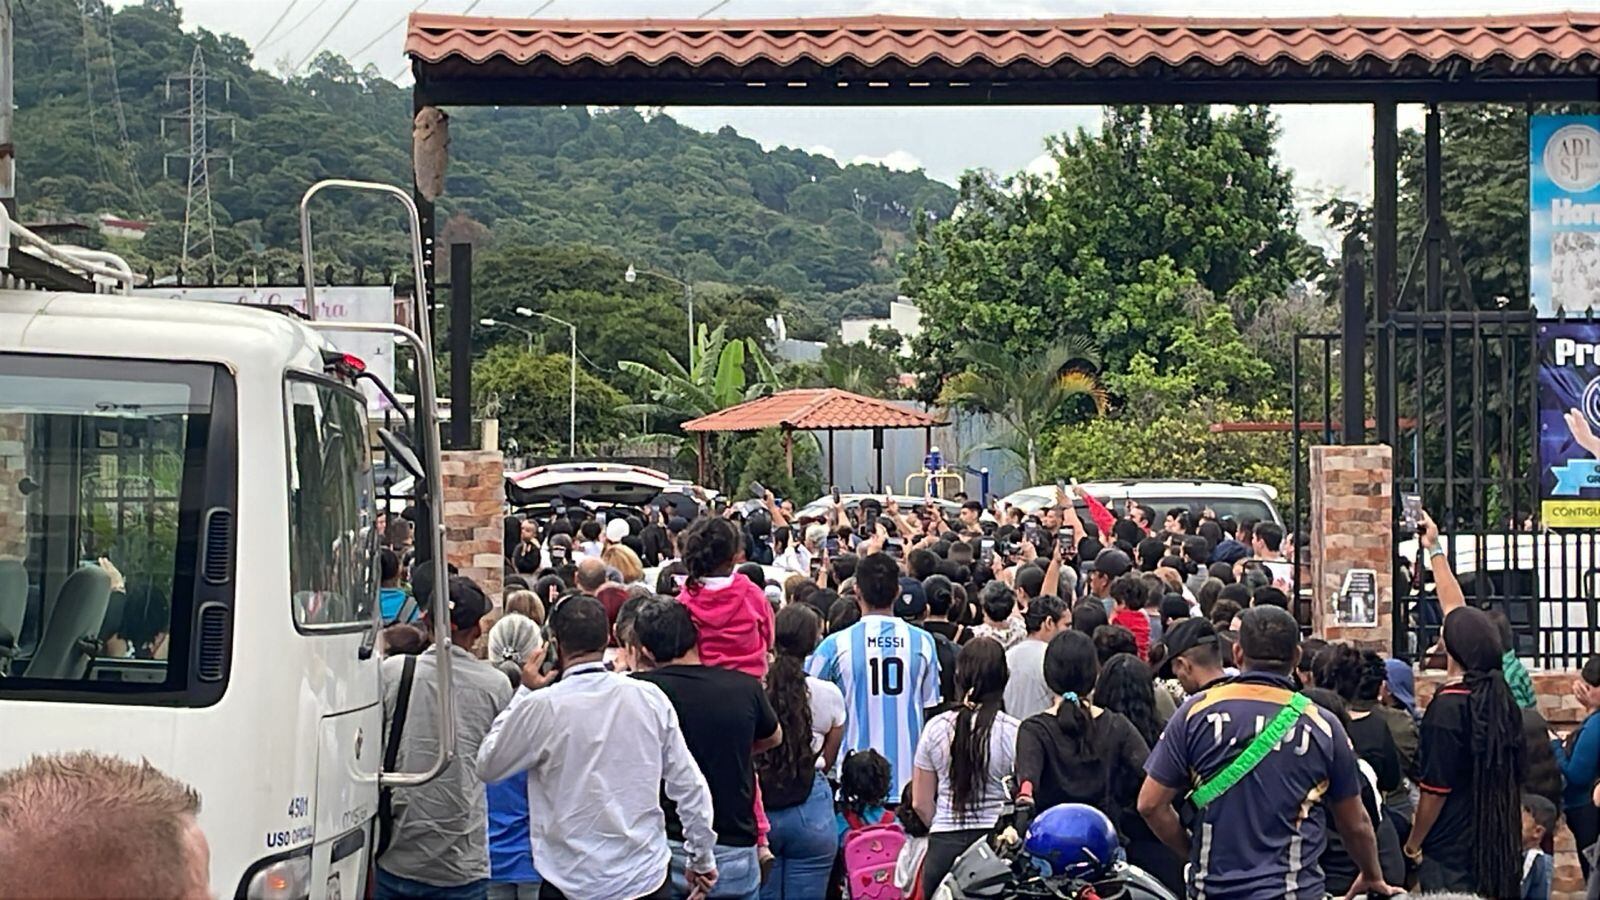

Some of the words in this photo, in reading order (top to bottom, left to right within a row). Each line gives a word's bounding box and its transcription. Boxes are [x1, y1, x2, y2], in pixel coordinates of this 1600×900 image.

[1559, 138, 1591, 156] ADI
[1560, 157, 1579, 181] SJ
[867, 636, 904, 648] MESSI
[869, 657, 904, 696] 10
[288, 797, 309, 818] 4501
[266, 830, 290, 848] USO
